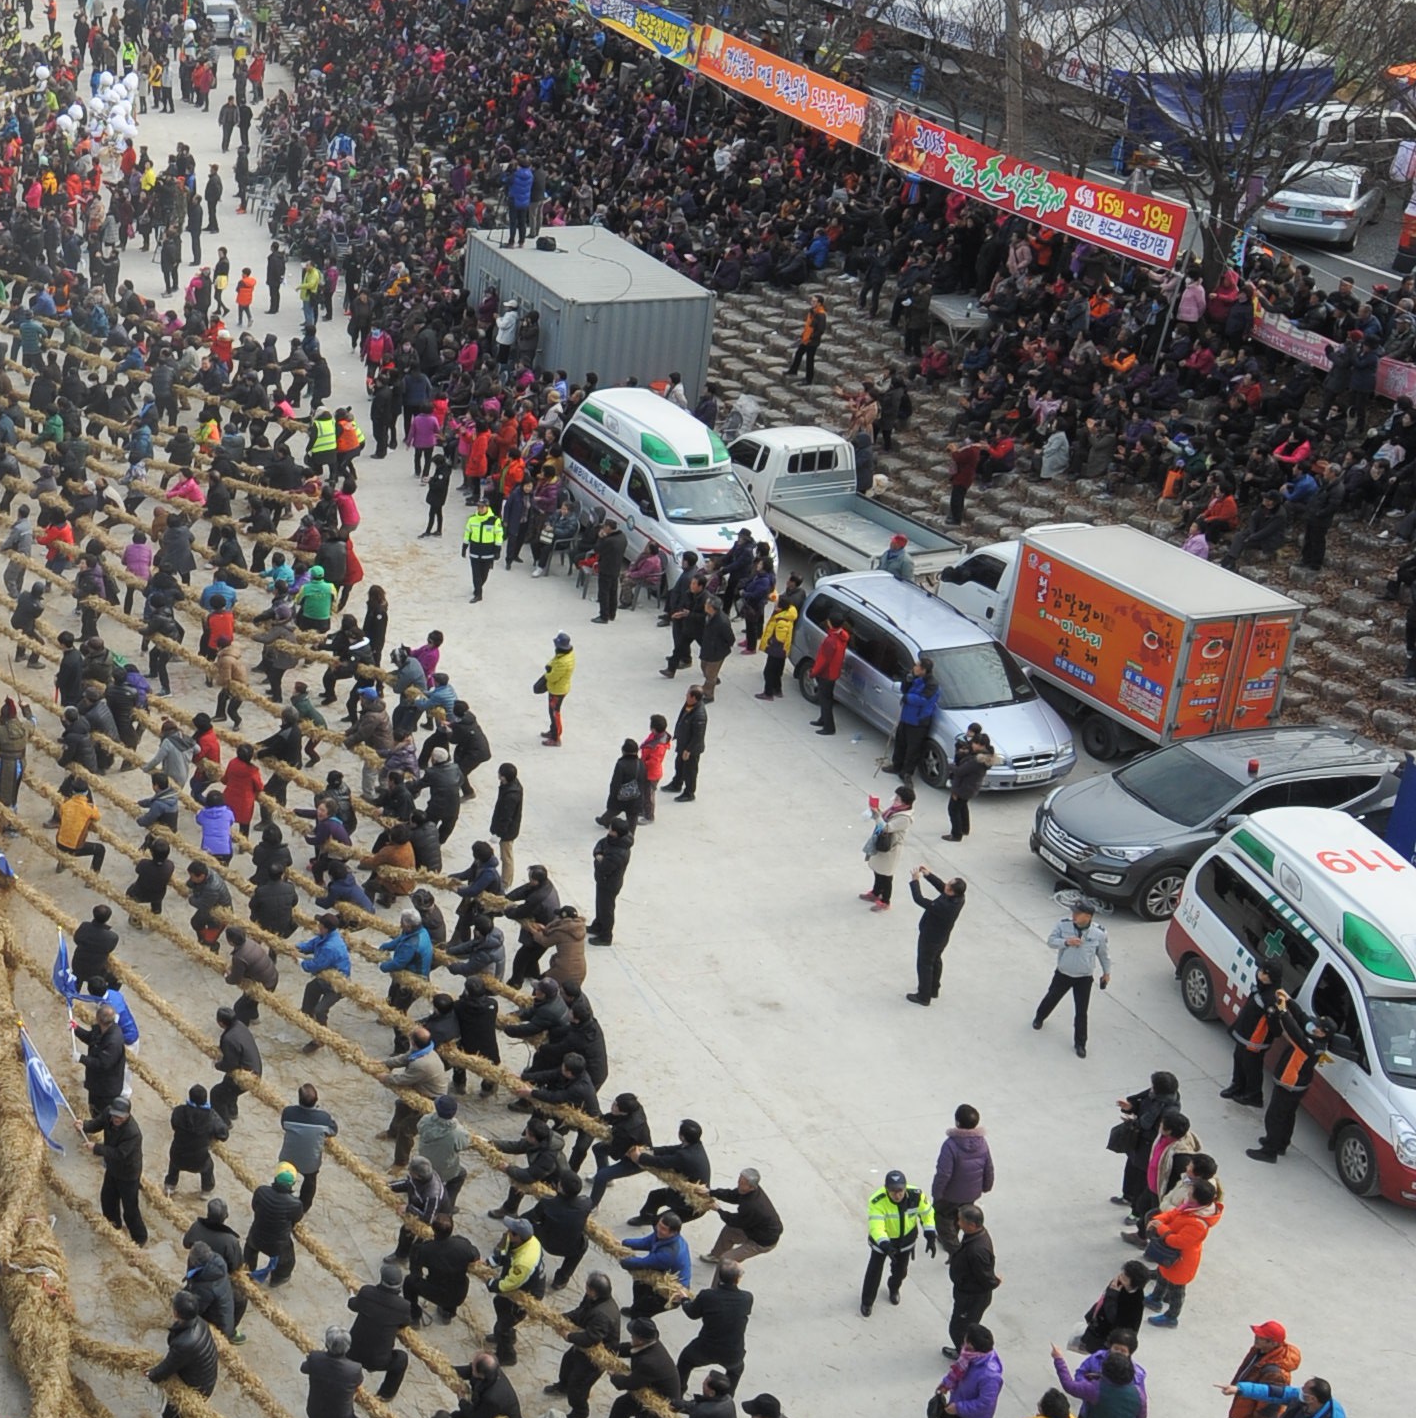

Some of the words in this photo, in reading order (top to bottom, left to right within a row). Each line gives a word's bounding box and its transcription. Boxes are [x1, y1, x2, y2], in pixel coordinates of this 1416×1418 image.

[1074, 185, 1095, 208] 4월
[1096, 191, 1125, 219] 15일
[1142, 203, 1173, 234] 19일
[1070, 208, 1093, 231] 5일간
[1098, 218, 1169, 256] 청도소싸움경기장
[569, 462, 606, 496] AMBULANCE
[1052, 588, 1104, 622] 감말랭이
[1061, 619, 1102, 649] 미나리
[1316, 850, 1406, 874] 119
